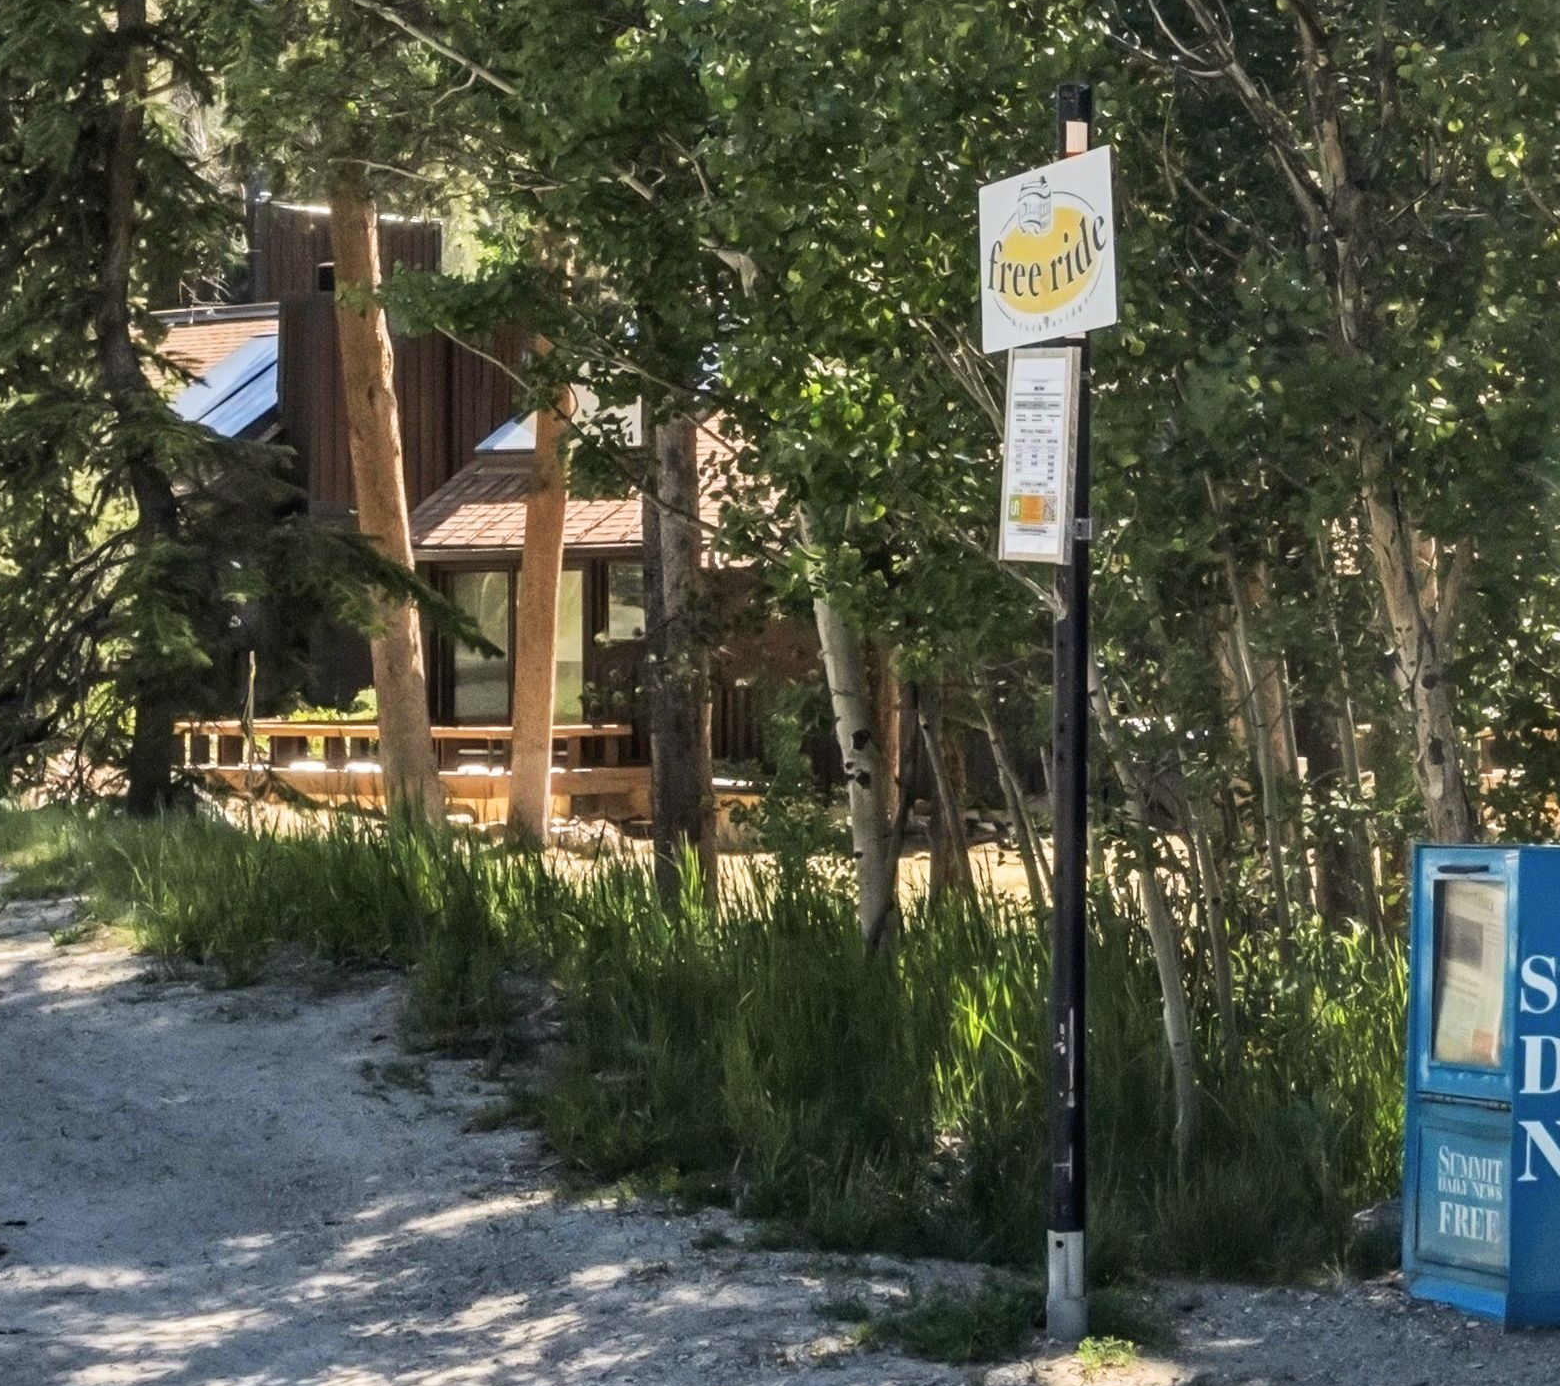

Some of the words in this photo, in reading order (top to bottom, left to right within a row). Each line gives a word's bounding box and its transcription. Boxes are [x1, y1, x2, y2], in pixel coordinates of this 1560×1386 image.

[987, 240, 1042, 297] free
[1051, 214, 1107, 292] ride
[1438, 1145, 1503, 1185] SUMMIT
[1438, 1176, 1467, 1196] DAILY
[1472, 1181, 1503, 1202] NEWS
[1438, 1201, 1501, 1244] FREE
